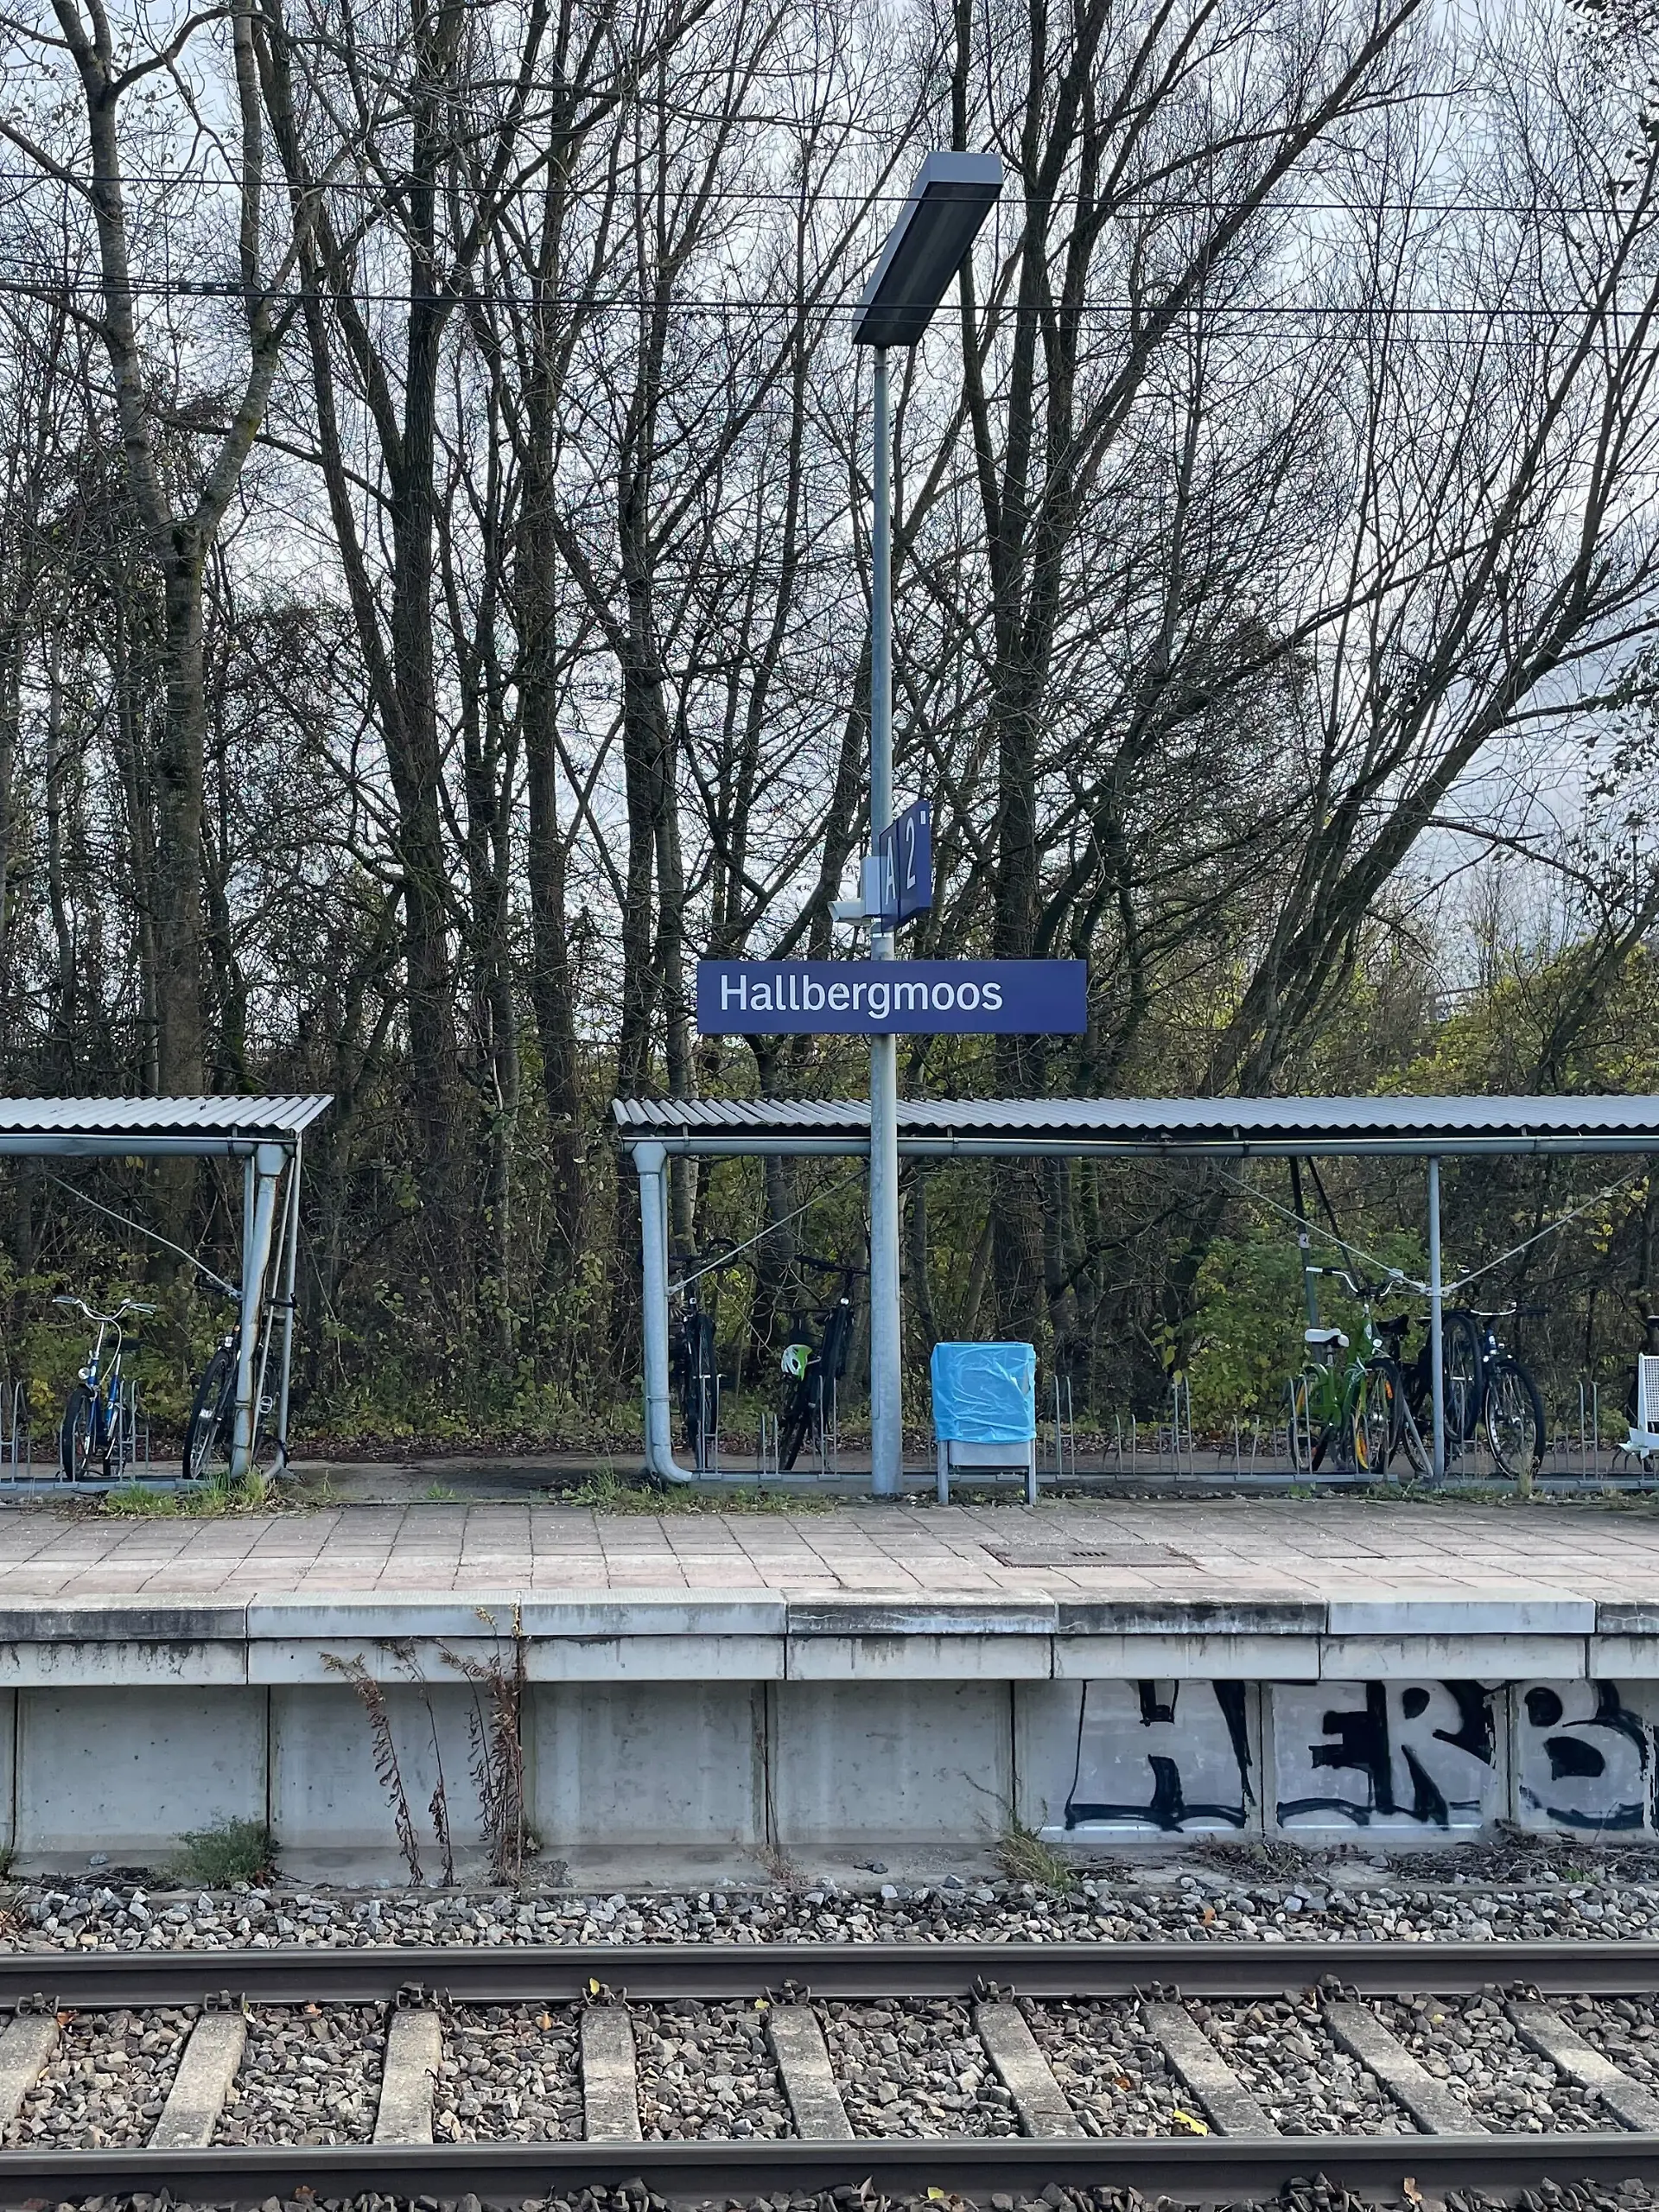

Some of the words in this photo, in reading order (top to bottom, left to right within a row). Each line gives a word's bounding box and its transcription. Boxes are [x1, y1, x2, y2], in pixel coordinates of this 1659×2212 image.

[885, 836, 896, 906] A
[906, 817, 916, 890] 2
[720, 975, 1003, 1019] Hallbergmoos
